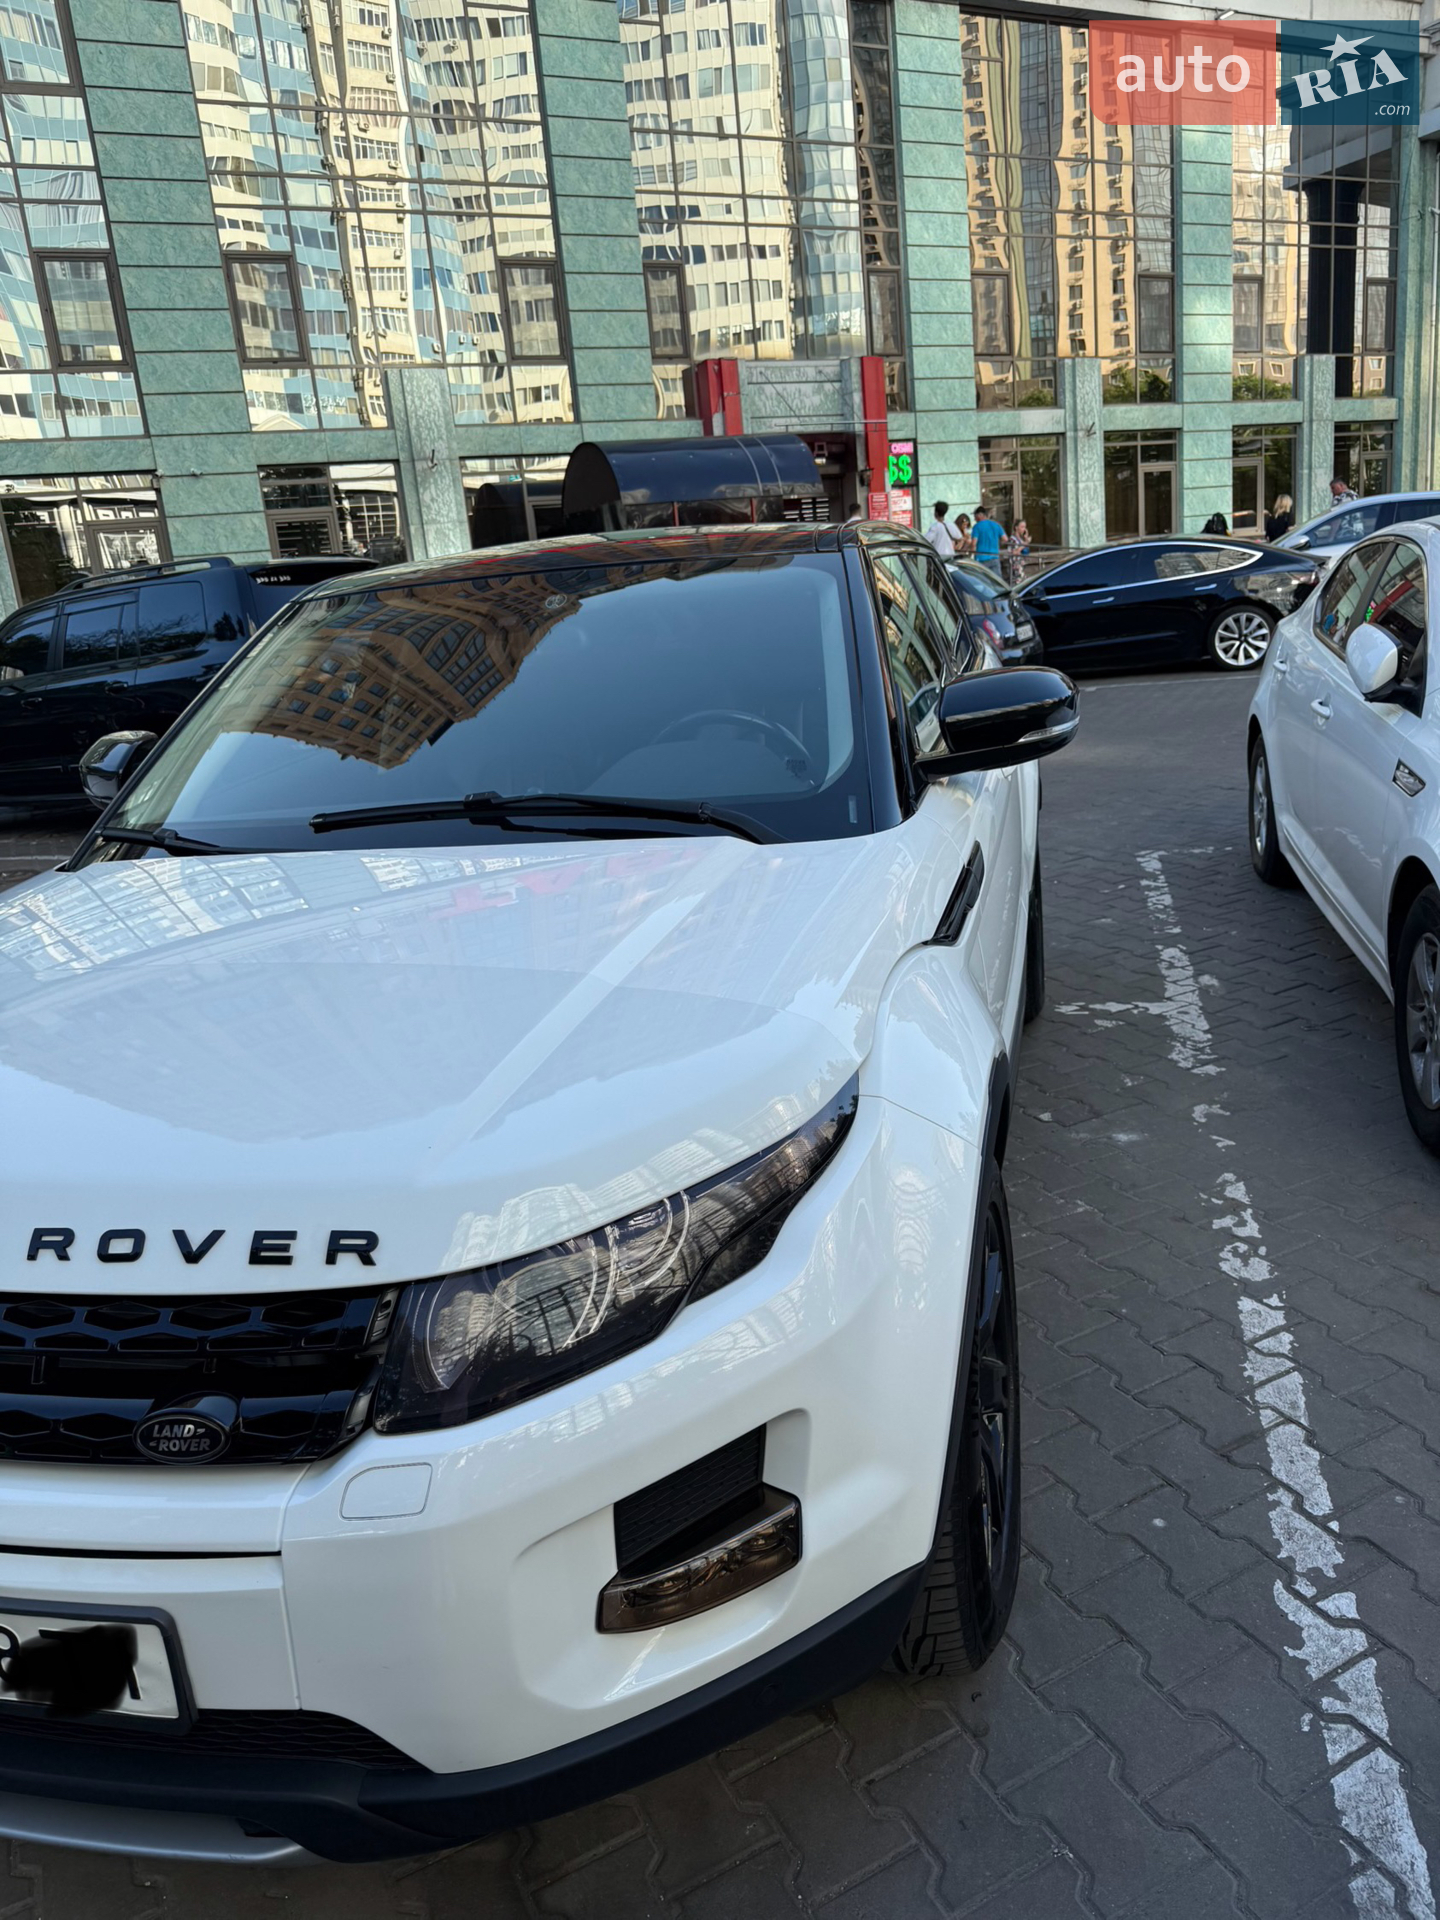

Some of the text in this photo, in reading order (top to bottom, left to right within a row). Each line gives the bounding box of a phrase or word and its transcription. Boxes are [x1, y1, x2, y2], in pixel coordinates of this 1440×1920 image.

[26, 1227, 381, 1267] ROVER
[152, 1424, 196, 1438] LAND
[158, 1438, 211, 1452] ROVER
